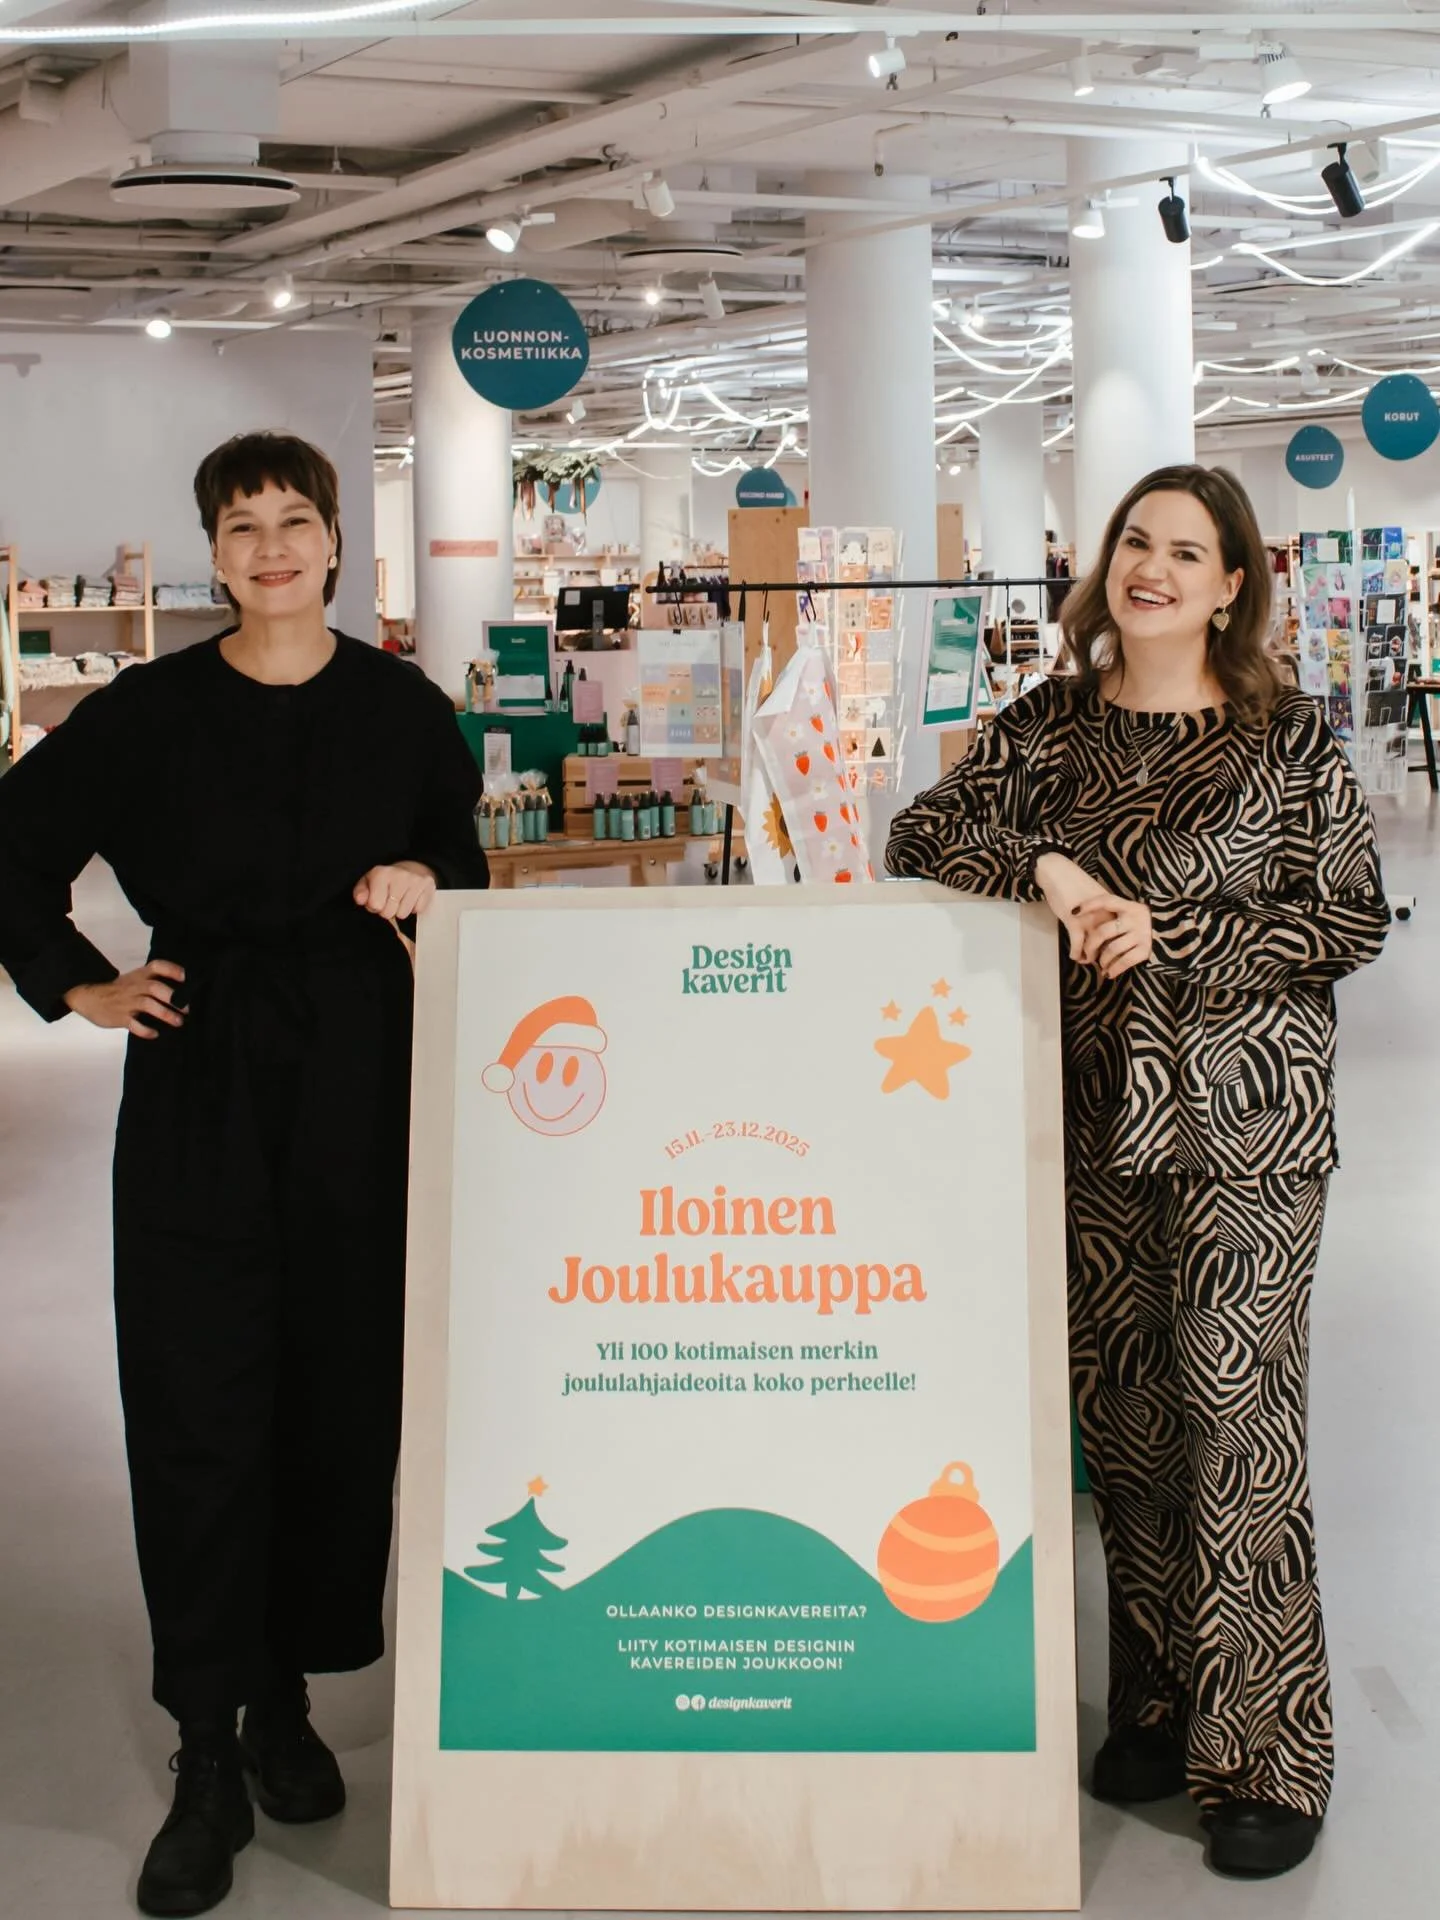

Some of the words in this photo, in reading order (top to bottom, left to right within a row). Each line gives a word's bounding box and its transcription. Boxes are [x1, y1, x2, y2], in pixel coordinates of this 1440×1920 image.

[473, 330, 570, 343] LUONNON-
[461, 347, 583, 360] KOSMETIIKKA
[691, 942, 793, 973] Design
[681, 967, 788, 994] kaverit
[639, 1185, 837, 1236] Iloinen
[548, 1252, 928, 1316] Joulukauppa
[596, 1341, 624, 1360] Yli
[630, 1343, 668, 1360] 100
[674, 1341, 794, 1361] kotimaisen
[800, 1340, 879, 1360] merkin
[561, 1372, 747, 1396] joululahjaideoita
[753, 1372, 805, 1392] koko
[810, 1372, 916, 1396] perheelle!
[606, 1605, 698, 1618] OLLAANKO
[703, 1605, 868, 1618] DESIGNKAVEREITA?
[617, 1639, 659, 1652] LIITY
[664, 1639, 768, 1652] KOTIMAISEN
[774, 1639, 856, 1652] DESIGNIN
[630, 1656, 738, 1670] KAVEREIDEN
[742, 1656, 843, 1670] JOUKKOON!
[707, 1696, 793, 1711] designkaverit
